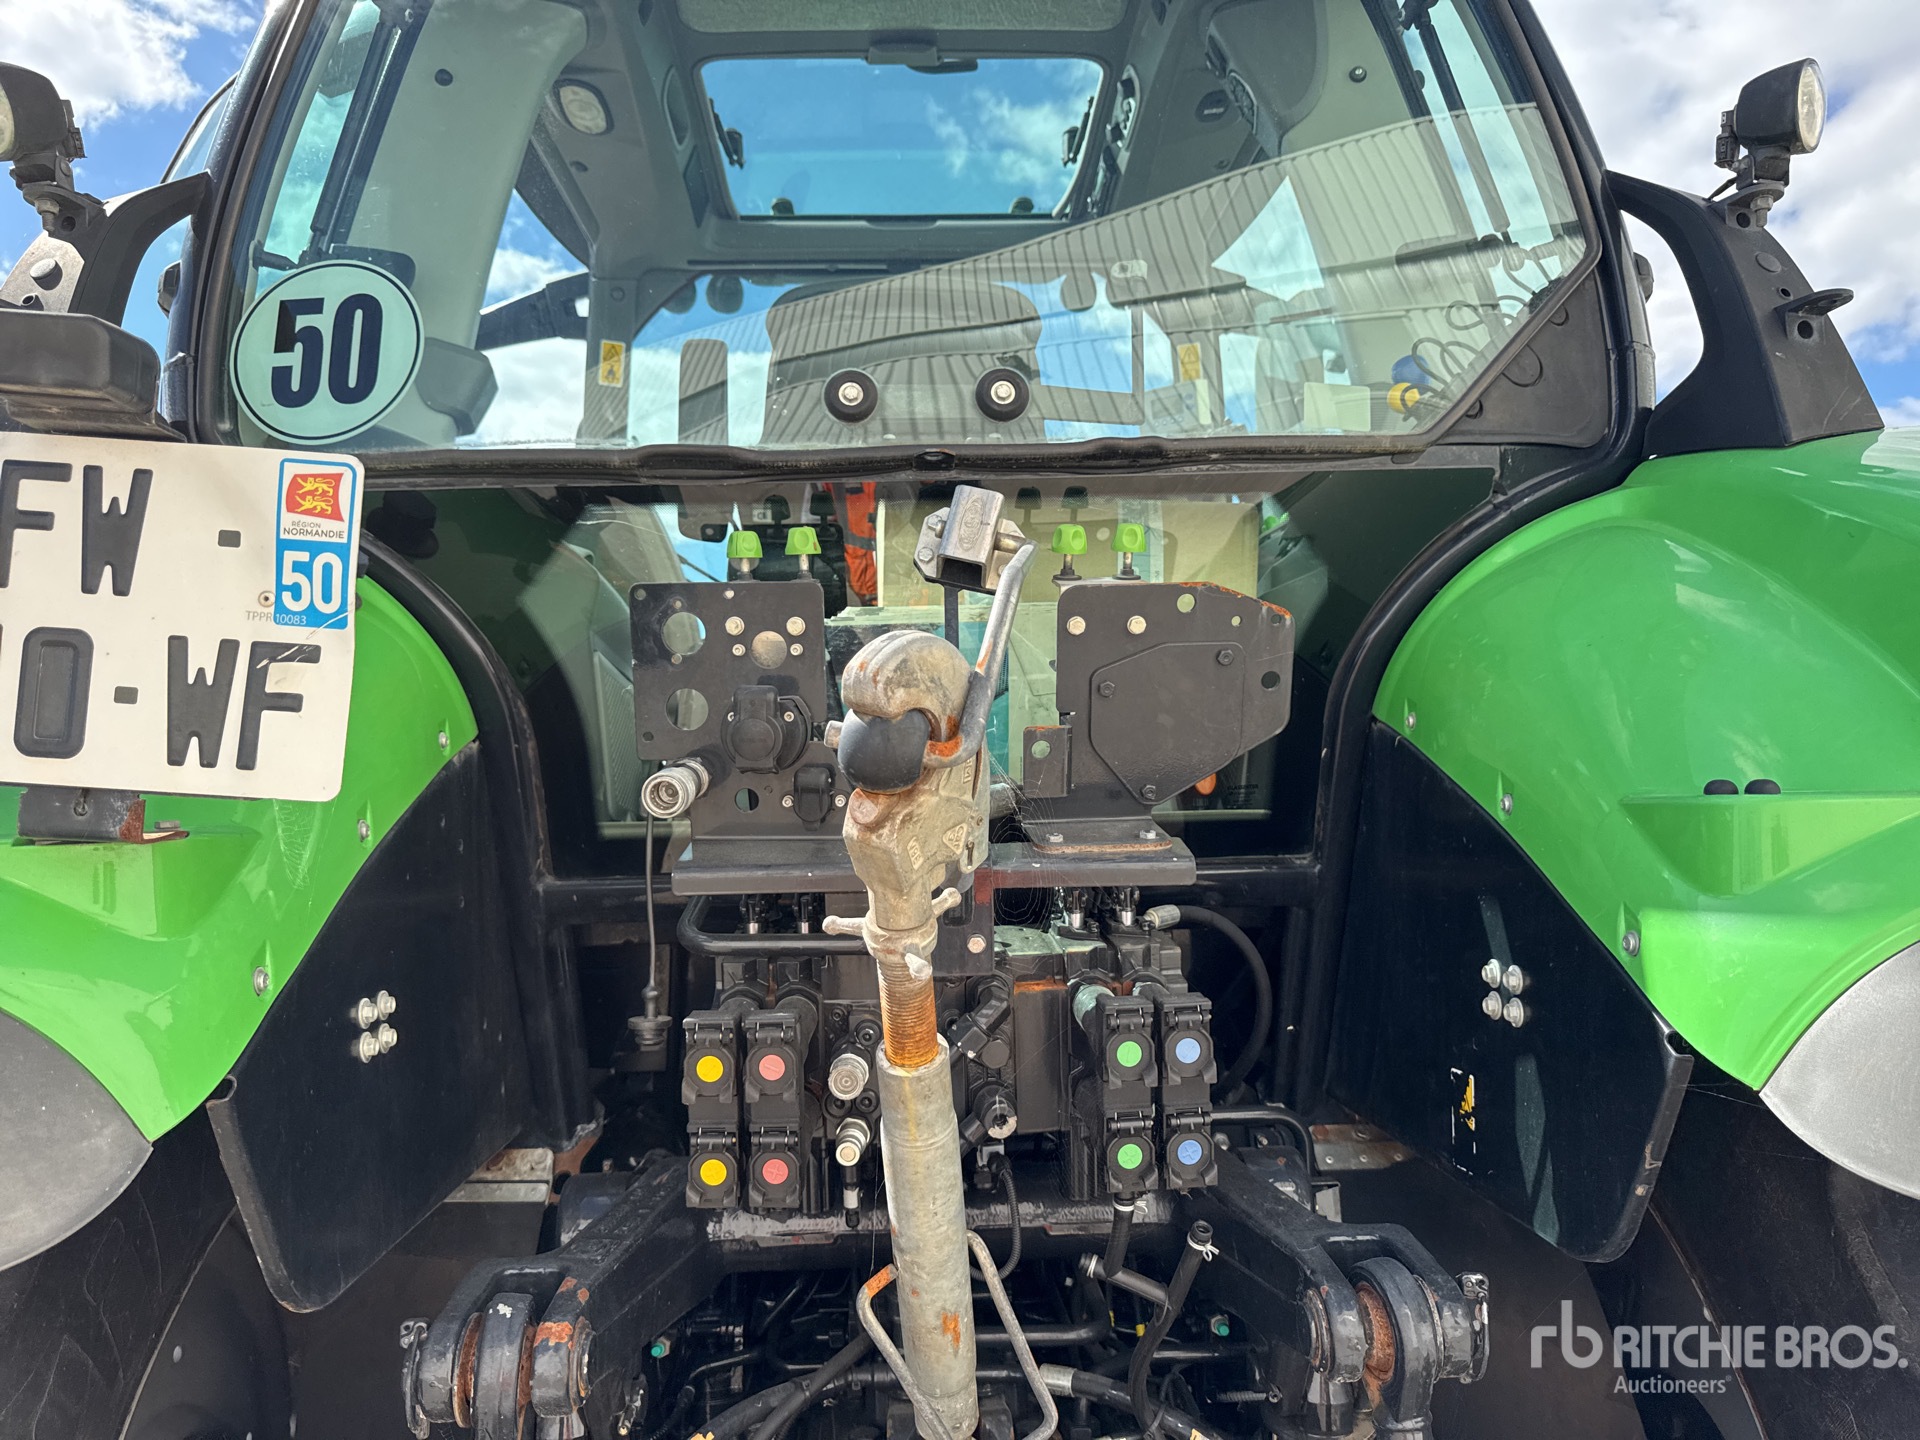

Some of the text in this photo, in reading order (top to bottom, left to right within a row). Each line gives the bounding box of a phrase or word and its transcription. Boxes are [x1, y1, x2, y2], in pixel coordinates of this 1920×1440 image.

[271, 293, 383, 408] 50
[291, 521, 321, 529] RÉGION
[283, 527, 345, 539] NORMANDIE
[281, 550, 343, 614] 50
[246, 611, 307, 625] TPPR 10083
